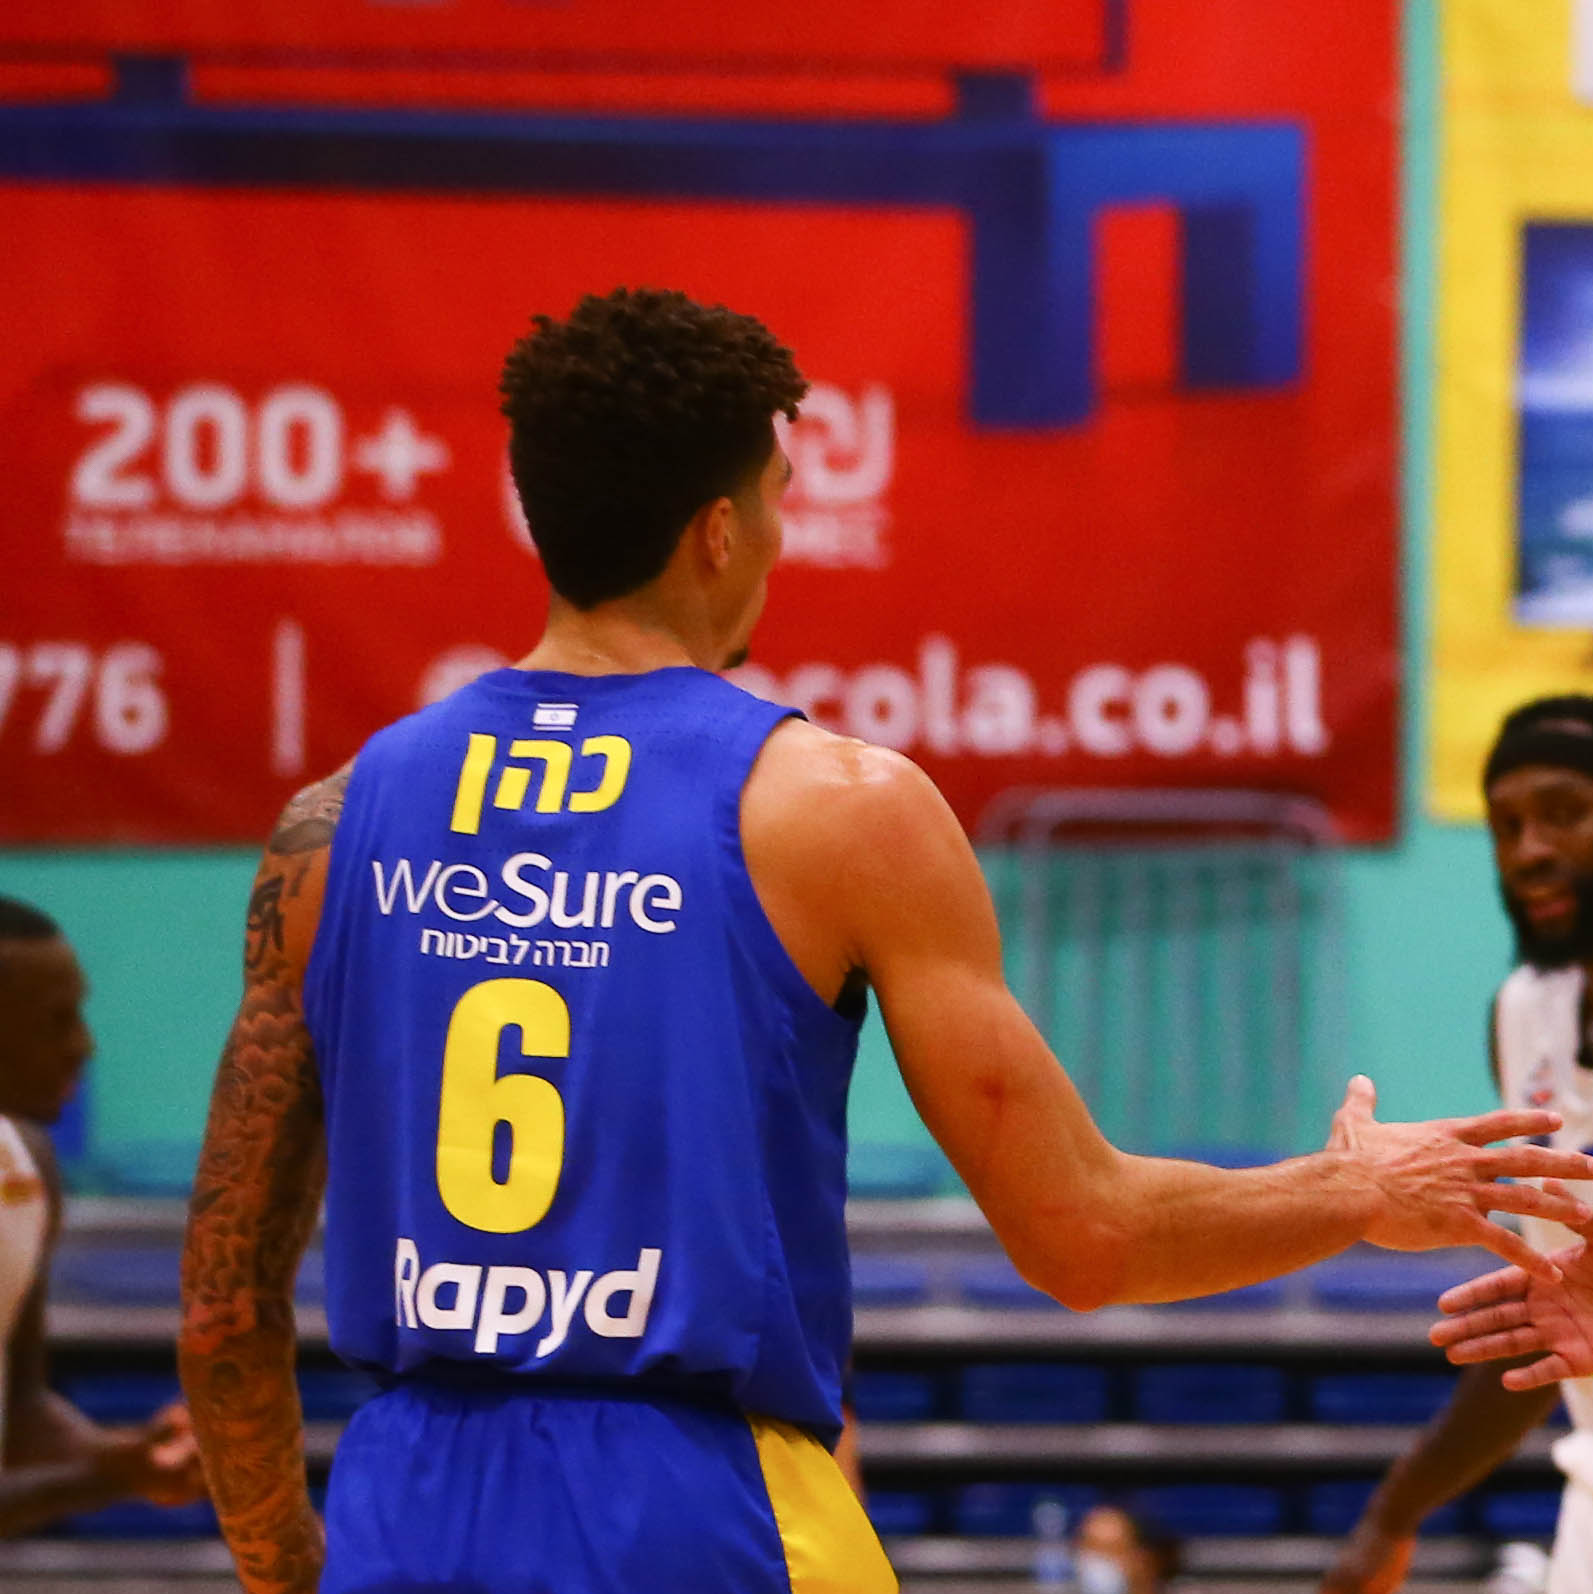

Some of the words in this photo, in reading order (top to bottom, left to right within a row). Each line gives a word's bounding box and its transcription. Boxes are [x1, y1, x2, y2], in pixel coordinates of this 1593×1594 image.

[70, 385, 447, 508] 200+
[450, 733, 632, 834] כהן
[371, 852, 683, 934] weSure
[420, 926, 527, 965] לביטוח
[533, 933, 609, 967] חברה
[436, 978, 571, 1233] 6
[394, 1238, 662, 1358] Rapyd
